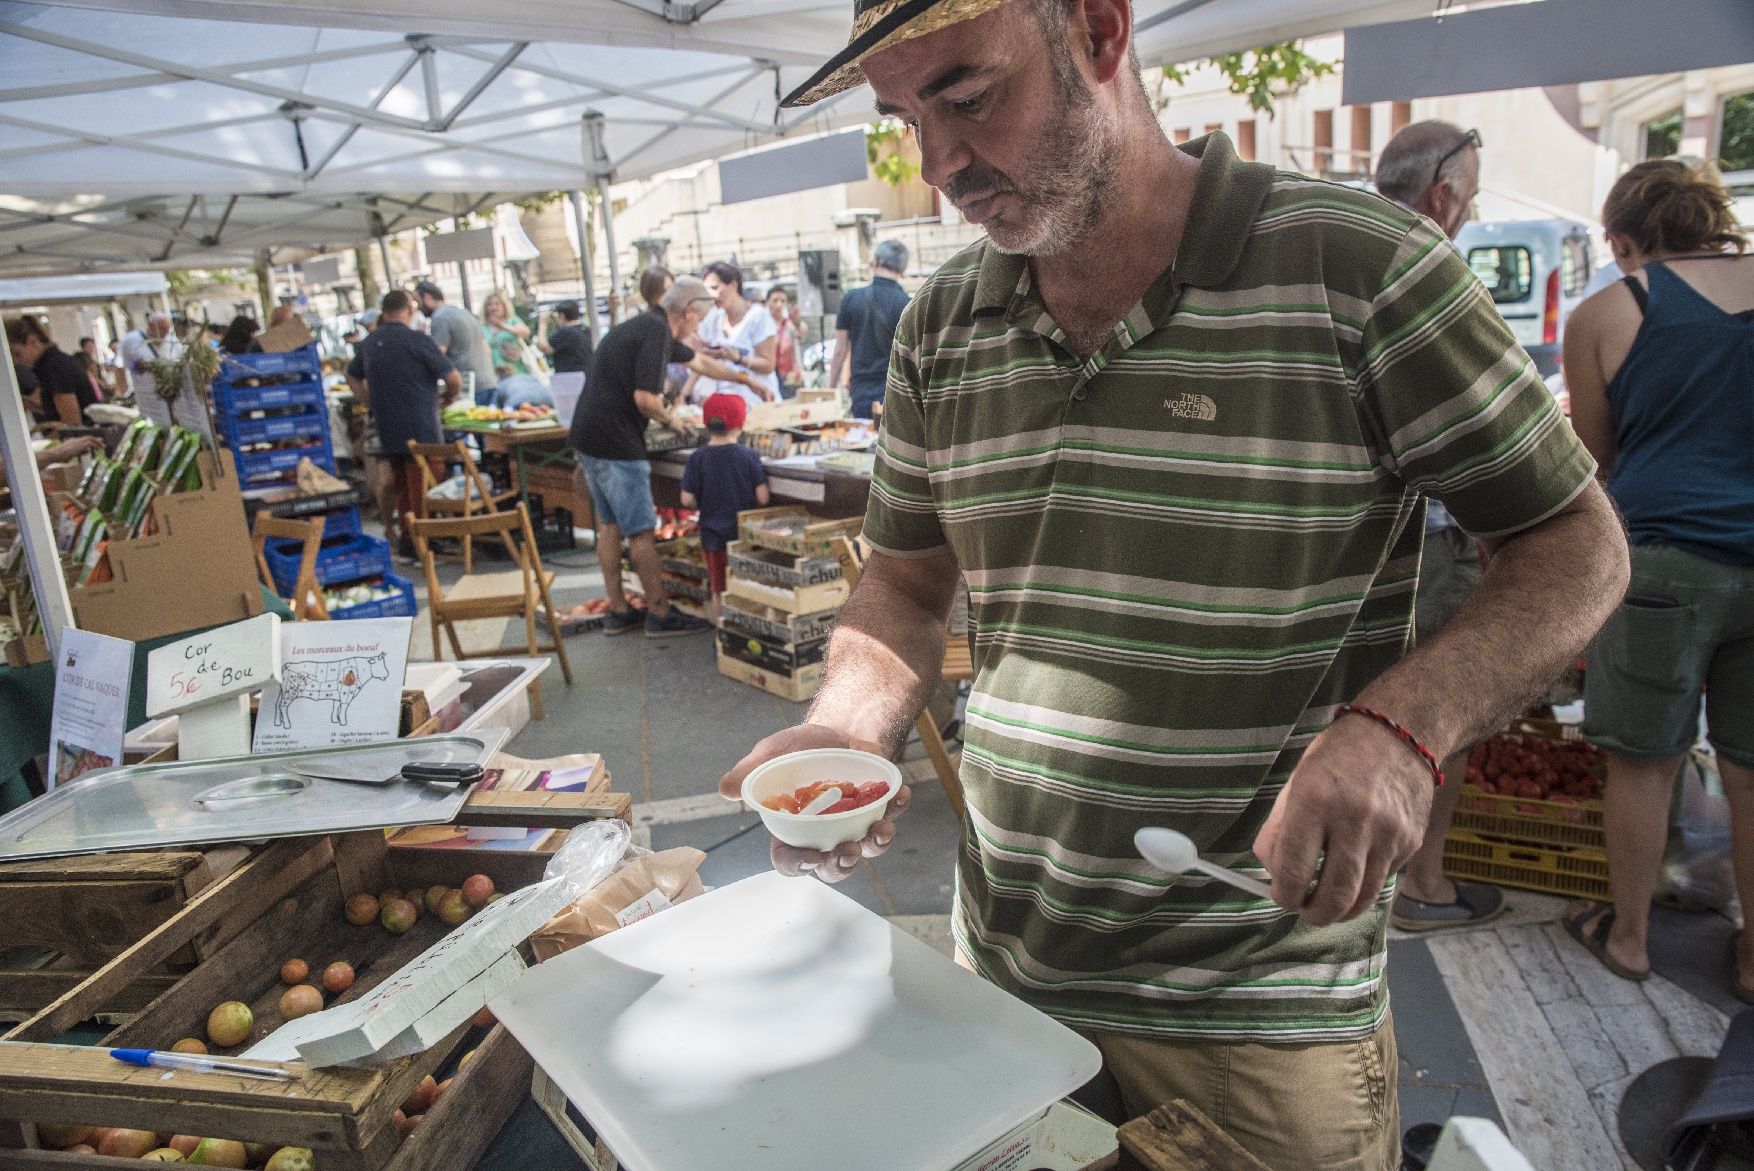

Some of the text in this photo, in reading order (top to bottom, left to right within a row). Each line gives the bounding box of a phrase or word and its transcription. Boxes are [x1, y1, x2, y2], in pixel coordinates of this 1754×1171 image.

[1163, 399, 1201, 410] NORTH
[1181, 393, 1201, 402] THE
[1172, 410, 1198, 419] FACE
[184, 642, 213, 660] Cor
[292, 641, 380, 656] Les morceaux du boeuf
[196, 658, 221, 674] de
[221, 667, 254, 687] Bou
[169, 671, 201, 699] 5€
